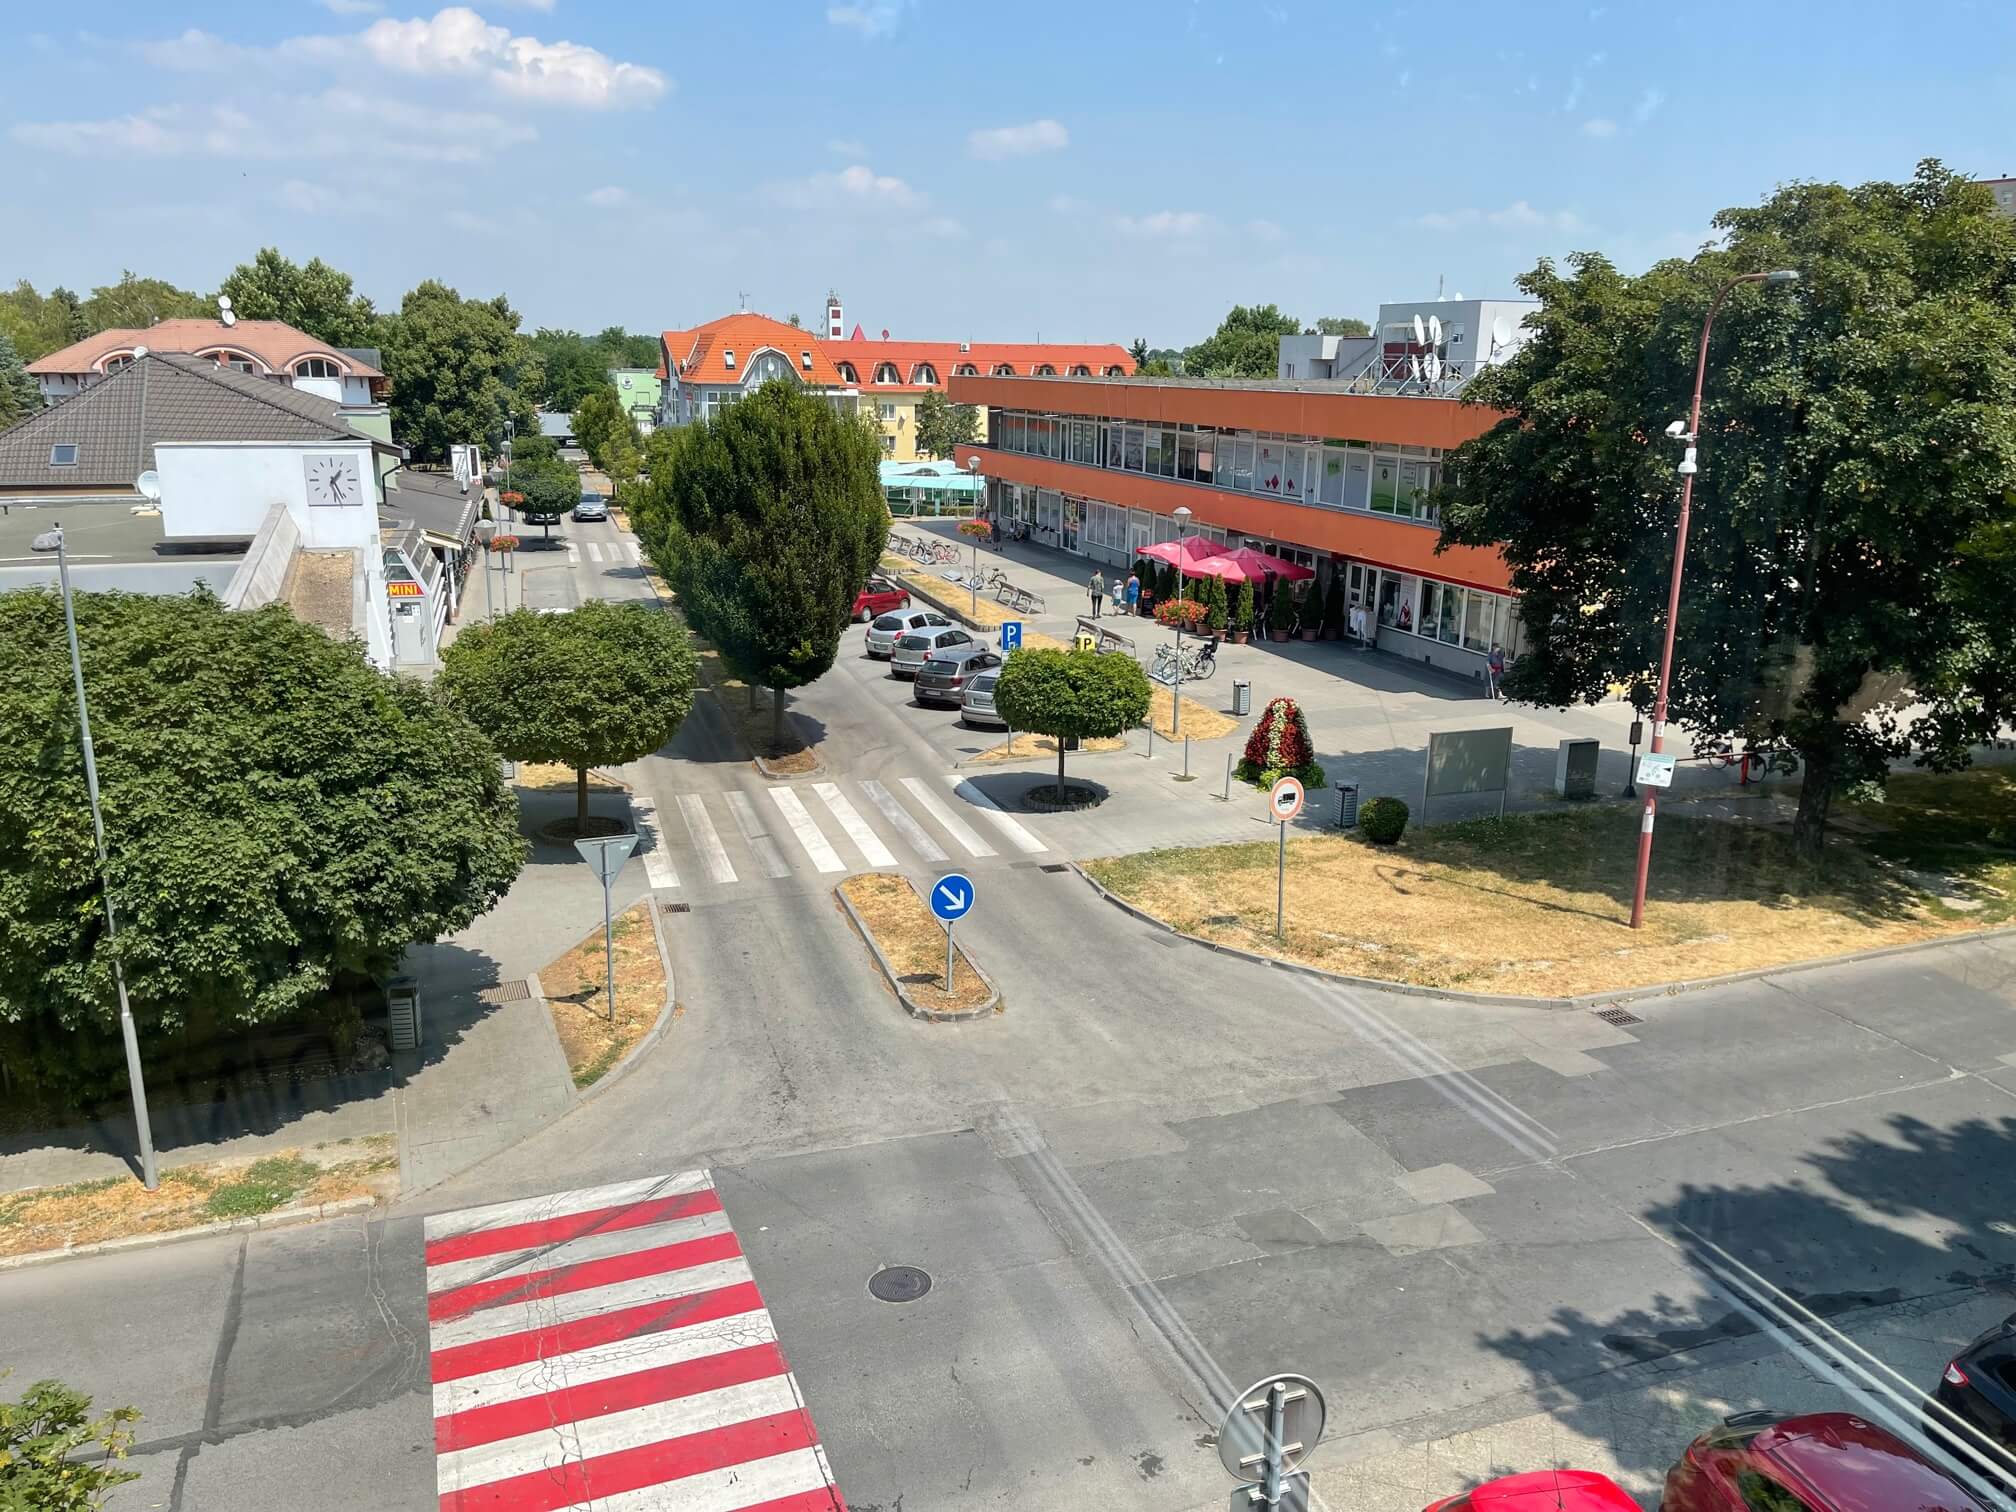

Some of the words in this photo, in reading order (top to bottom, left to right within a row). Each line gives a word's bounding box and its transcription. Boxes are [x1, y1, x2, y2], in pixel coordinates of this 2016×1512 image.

[389, 585, 417, 595] MINI
[1007, 625, 1016, 642] P
[1084, 638, 1092, 650] P
